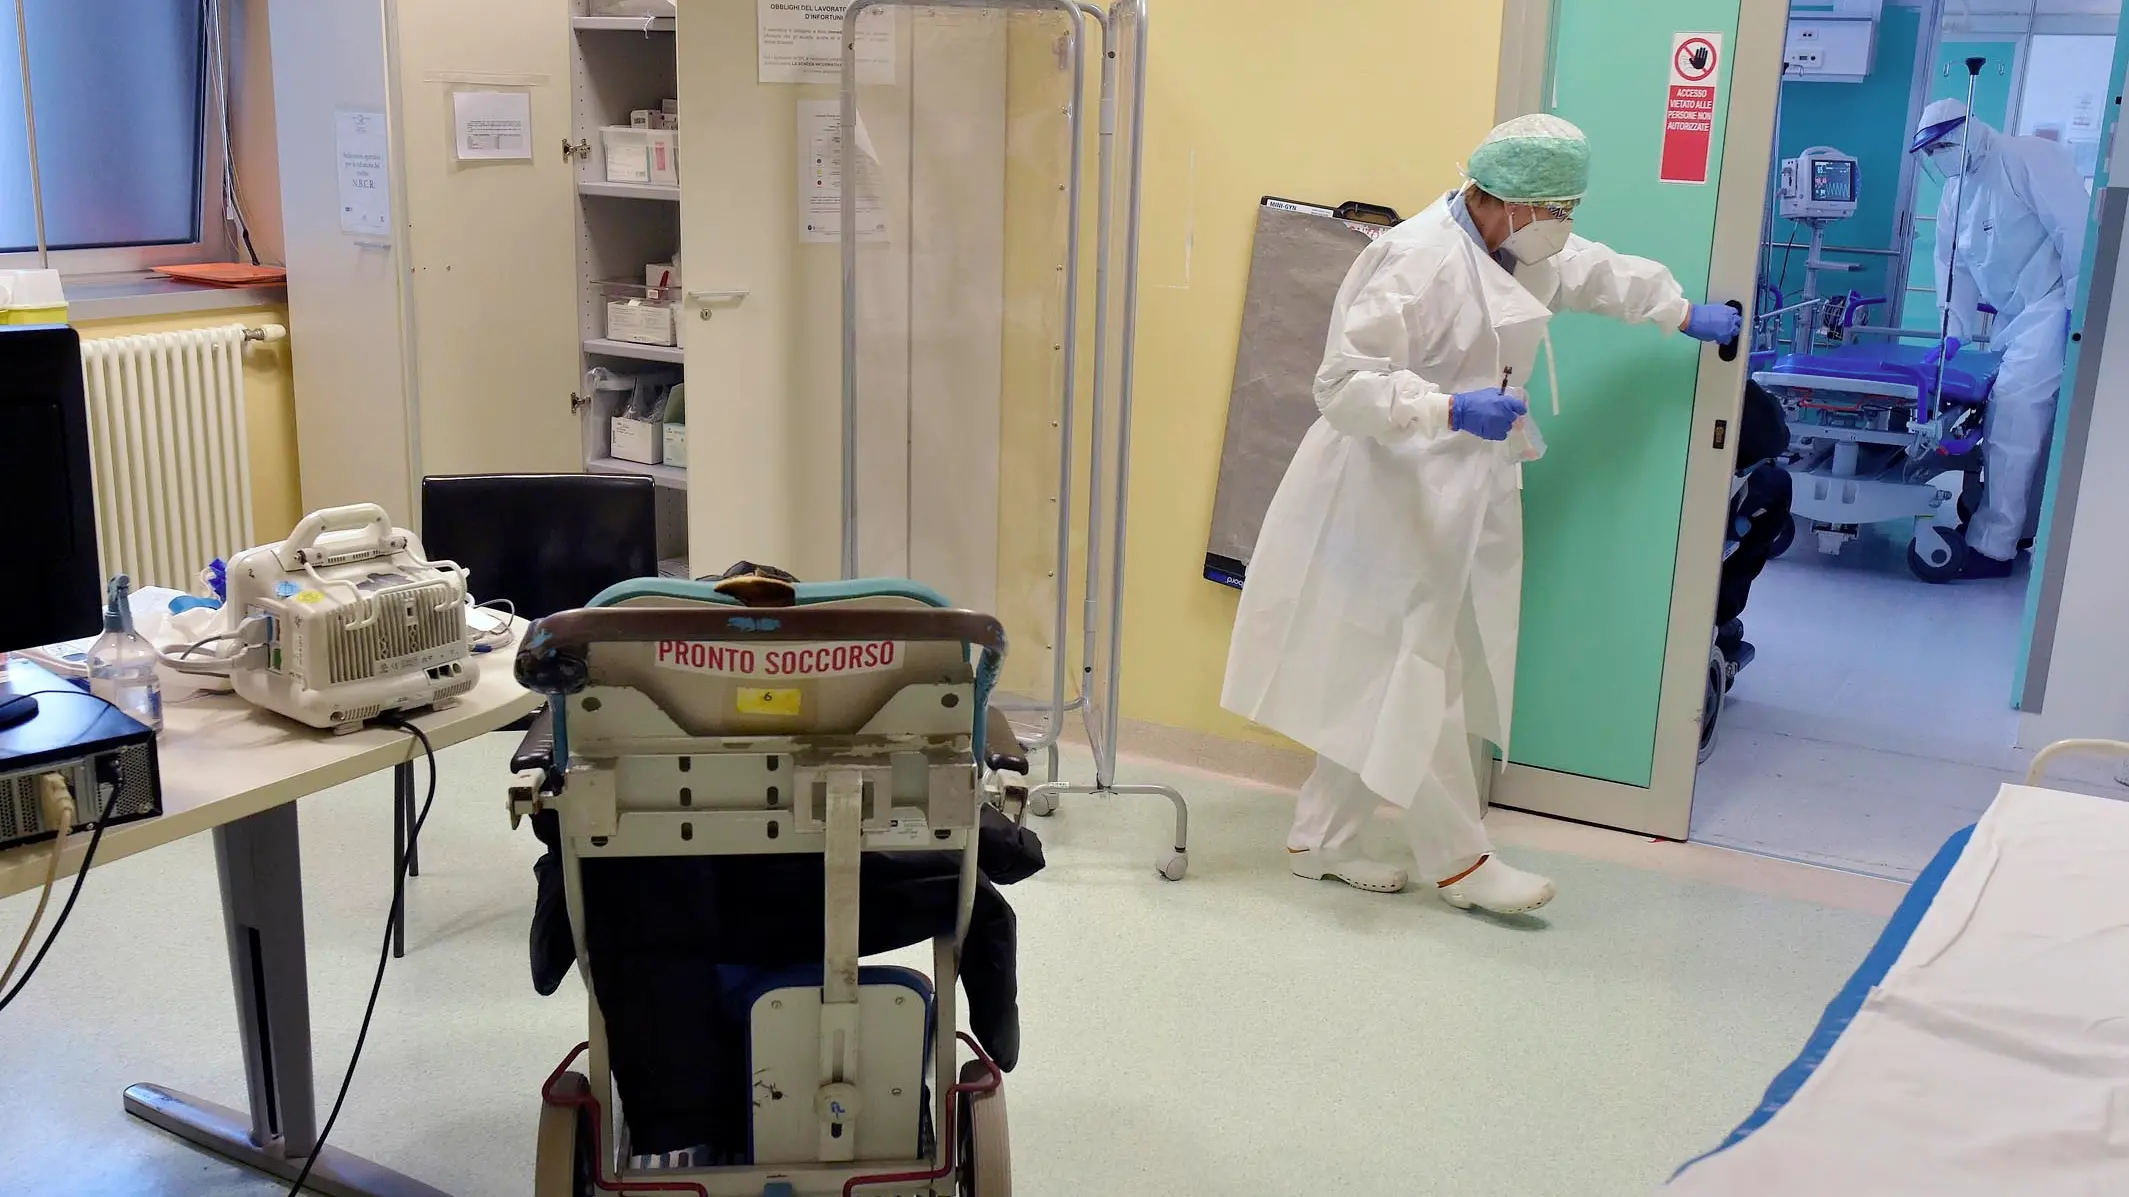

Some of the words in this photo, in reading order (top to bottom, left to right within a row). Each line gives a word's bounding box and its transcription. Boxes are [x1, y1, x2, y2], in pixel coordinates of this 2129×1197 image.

[770, 3, 800, 11] OBBLIGHI
[1676, 88, 1707, 98] ACCESSO
[1670, 99, 1696, 109] VIETATO
[1695, 100, 1713, 109] ALLE
[1668, 110, 1698, 120] PERSONE
[1697, 111, 1712, 121] NON
[1666, 121, 1711, 131] AUTORIZZATE
[1269, 201, 1297, 211] MINI-GYN
[658, 640, 755, 674] PRONTO
[764, 640, 894, 675] SOCCORSO
[763, 691, 773, 702] 6
